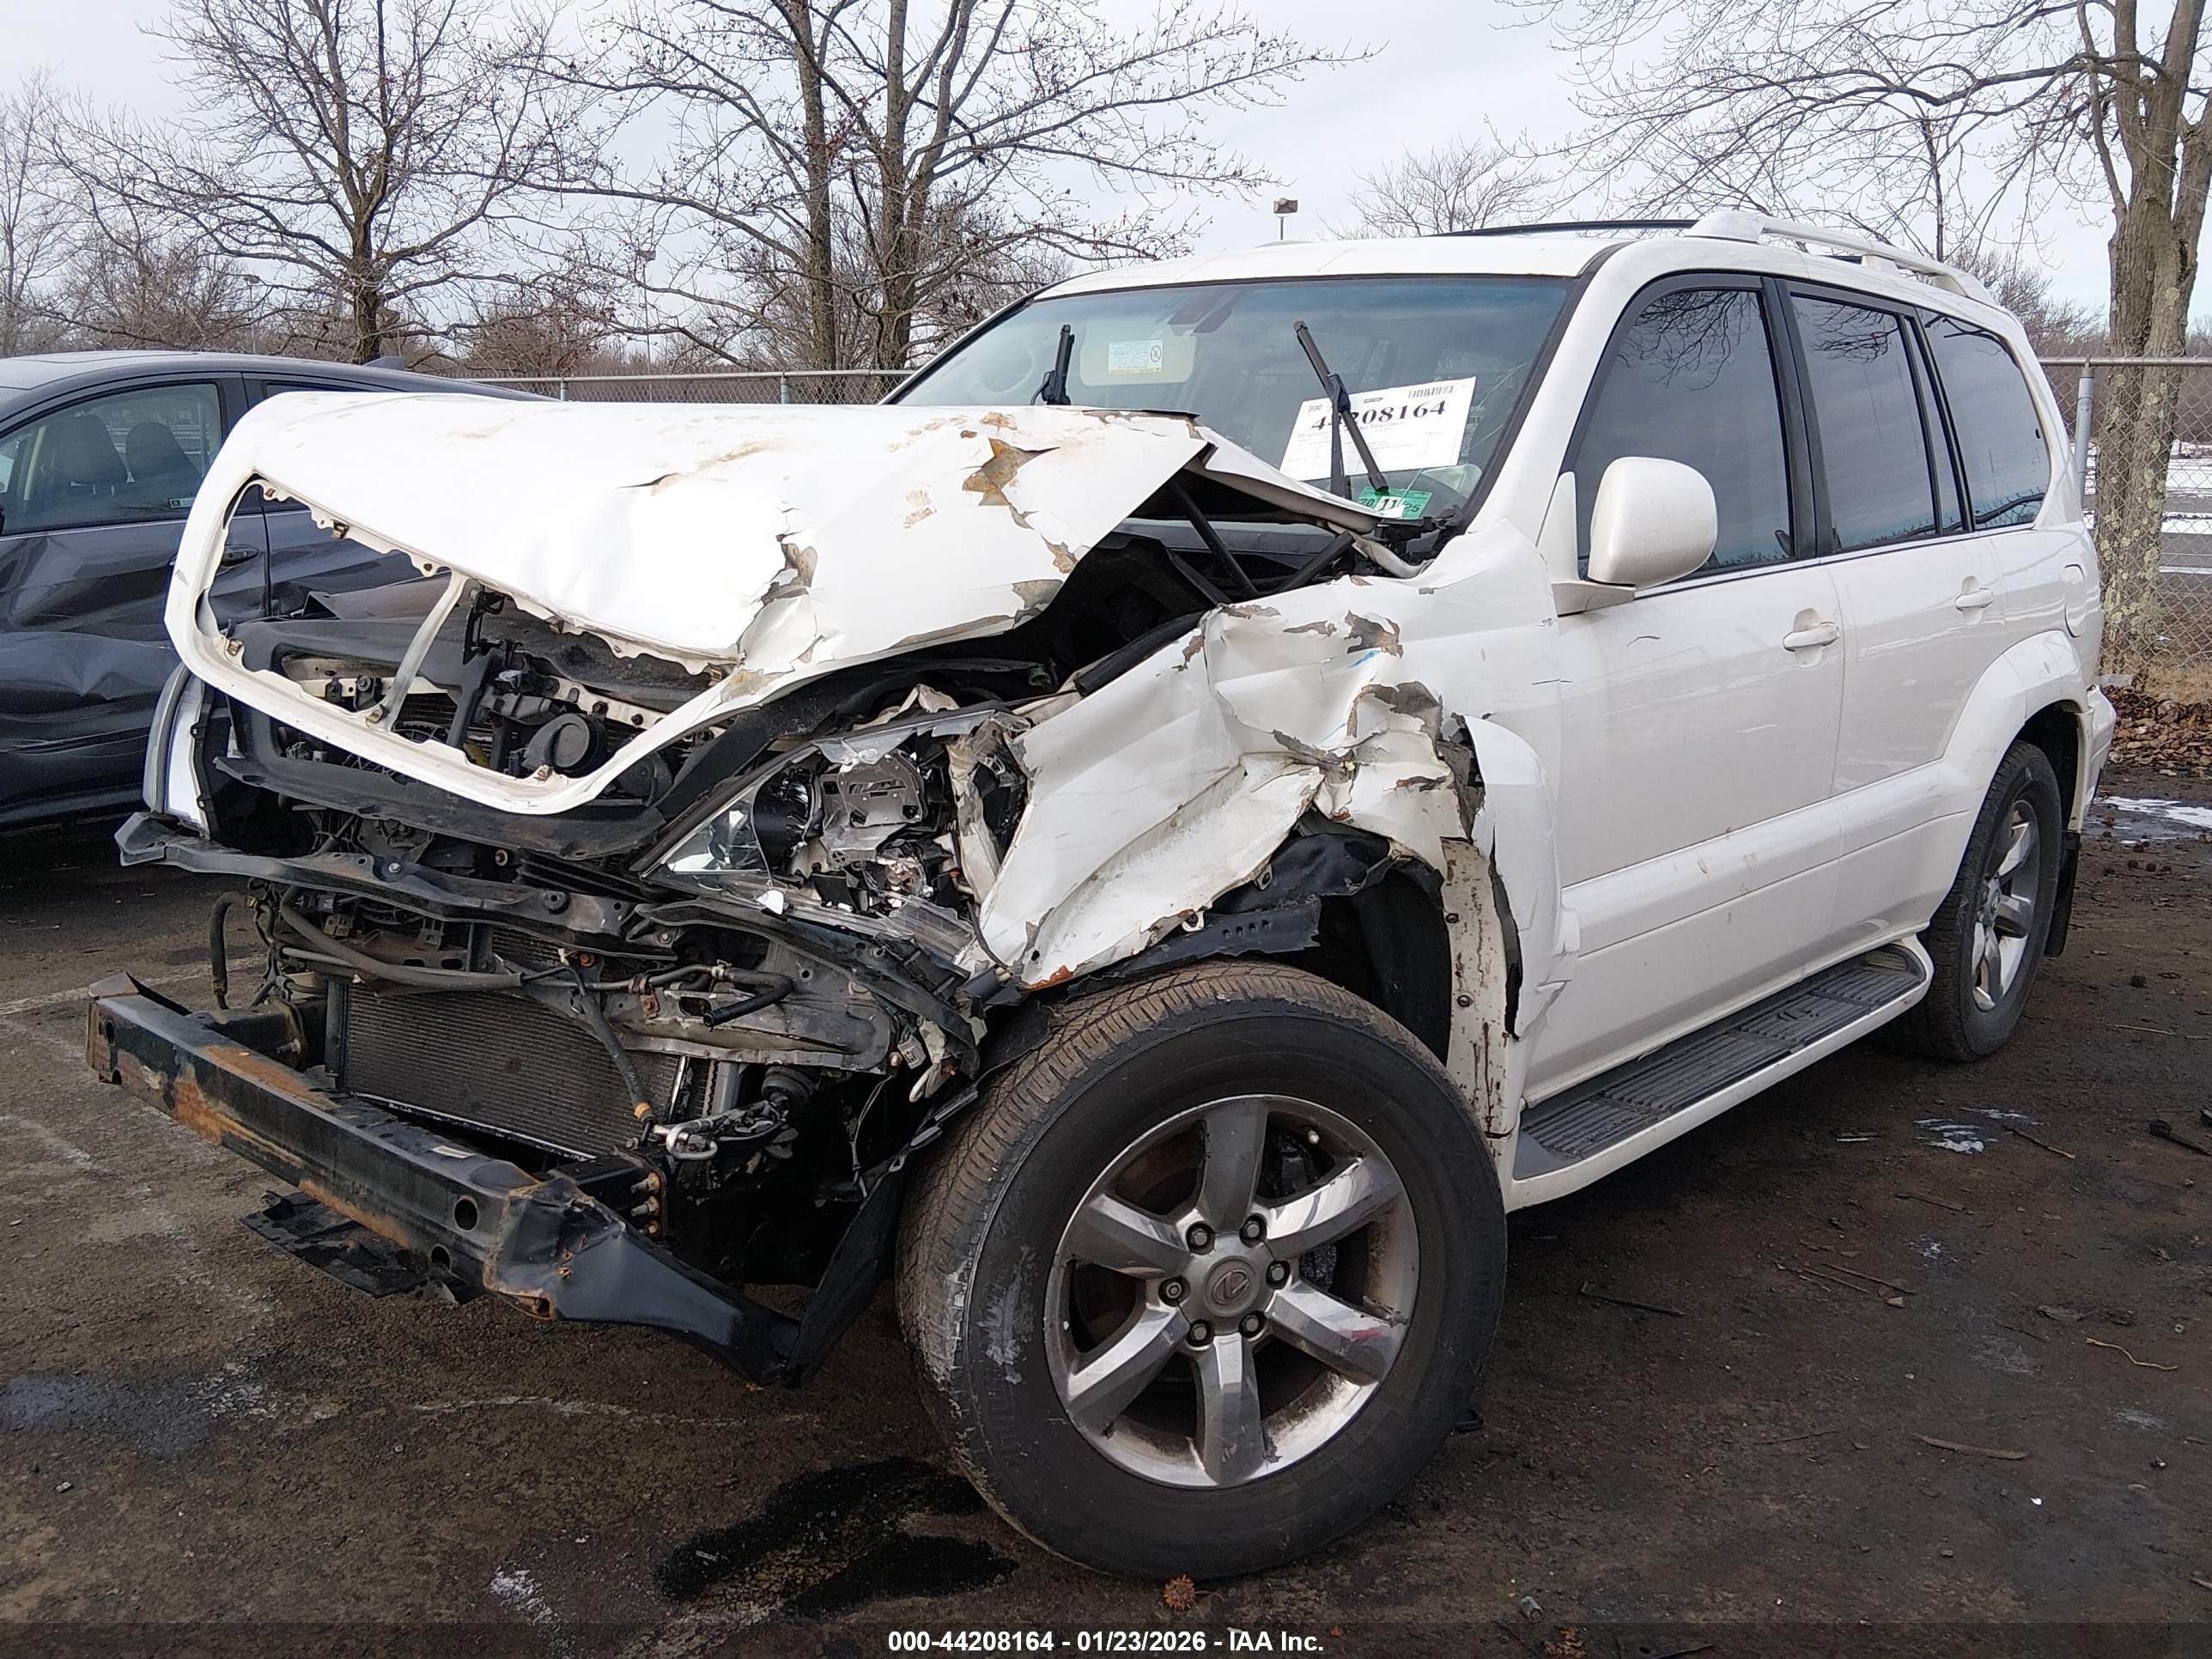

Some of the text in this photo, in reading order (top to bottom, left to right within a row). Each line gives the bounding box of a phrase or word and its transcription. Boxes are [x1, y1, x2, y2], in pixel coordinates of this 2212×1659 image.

[1360, 498, 1422, 513] 20 11 25
